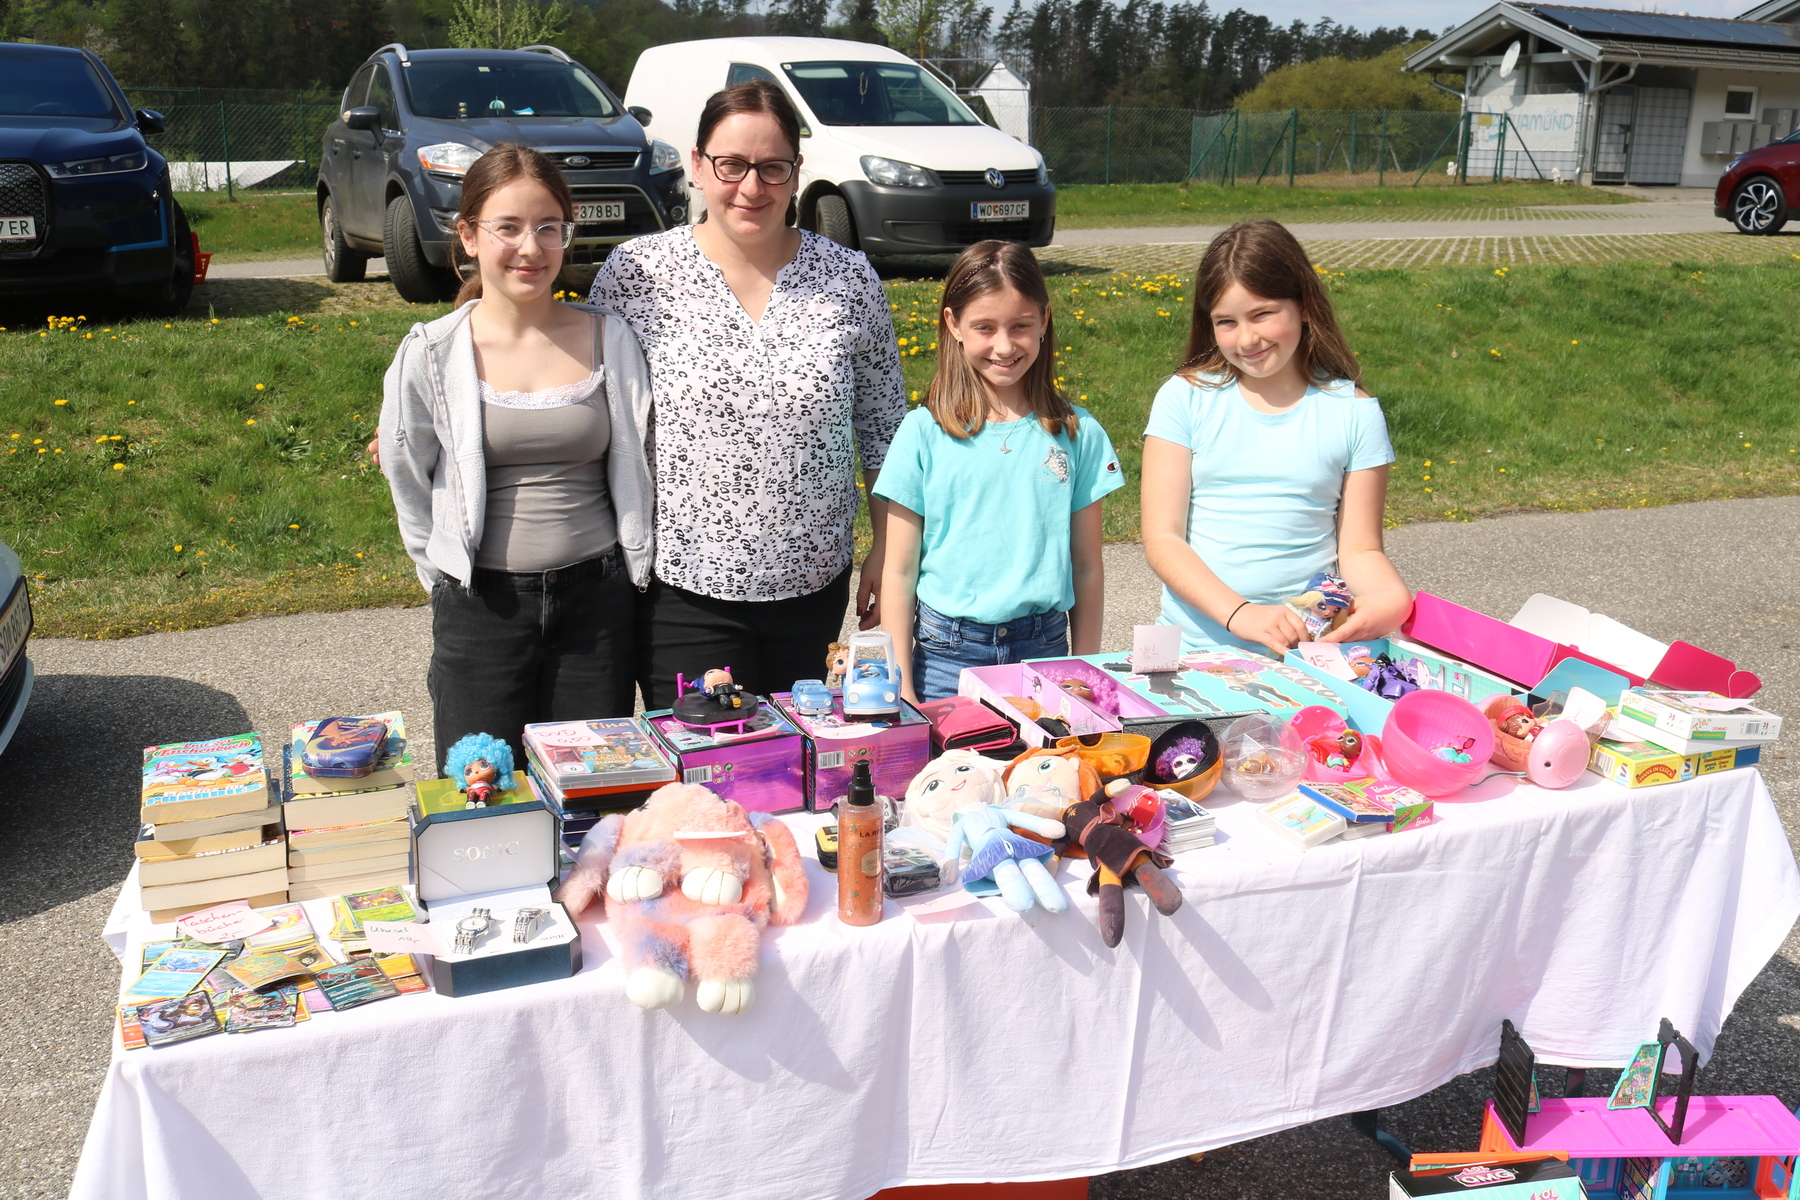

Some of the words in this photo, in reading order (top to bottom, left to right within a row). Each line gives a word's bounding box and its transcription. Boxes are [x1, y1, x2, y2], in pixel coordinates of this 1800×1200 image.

[580, 205, 603, 219] 378
[605, 204, 621, 218] BJ
[979, 204, 993, 217] WO
[998, 204, 1015, 216] 697
[1015, 203, 1026, 216] CF
[9, 220, 30, 236] ER
[588, 721, 631, 731] Tina
[534, 729, 577, 738] DVD
[557, 736, 591, 744] 0,50
[158, 741, 251, 757] Taschenbuch
[453, 840, 520, 863] SONIC
[540, 933, 567, 942] SONIC
